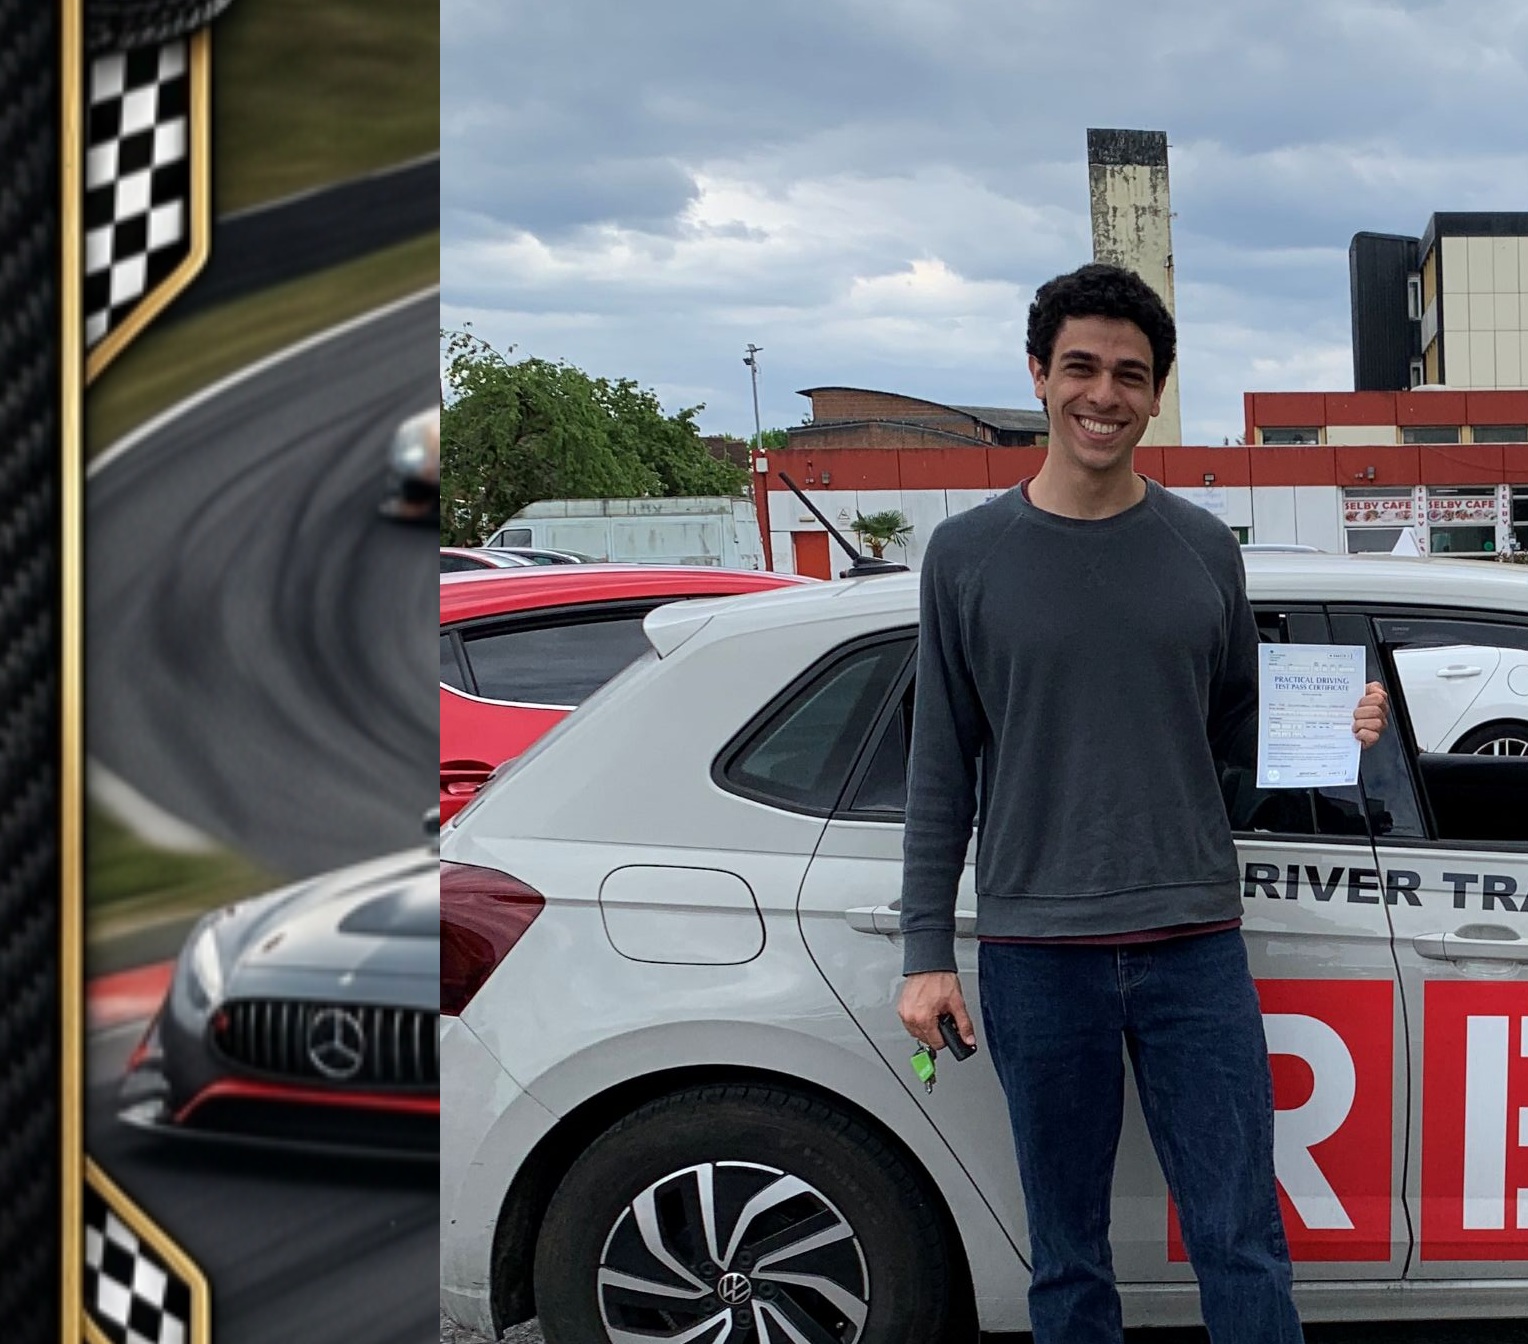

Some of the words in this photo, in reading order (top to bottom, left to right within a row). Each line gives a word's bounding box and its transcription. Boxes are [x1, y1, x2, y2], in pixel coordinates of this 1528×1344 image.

[1344, 501, 1379, 511] SELBY
[1382, 500, 1412, 510] CAFE
[1428, 500, 1462, 509] SELBY
[1465, 500, 1495, 509] CAFE
[1274, 676, 1314, 684] PRACTICAL
[1316, 676, 1349, 684] DRIVING
[1291, 683, 1307, 691] PASS
[1243, 862, 1424, 907] RIVER
